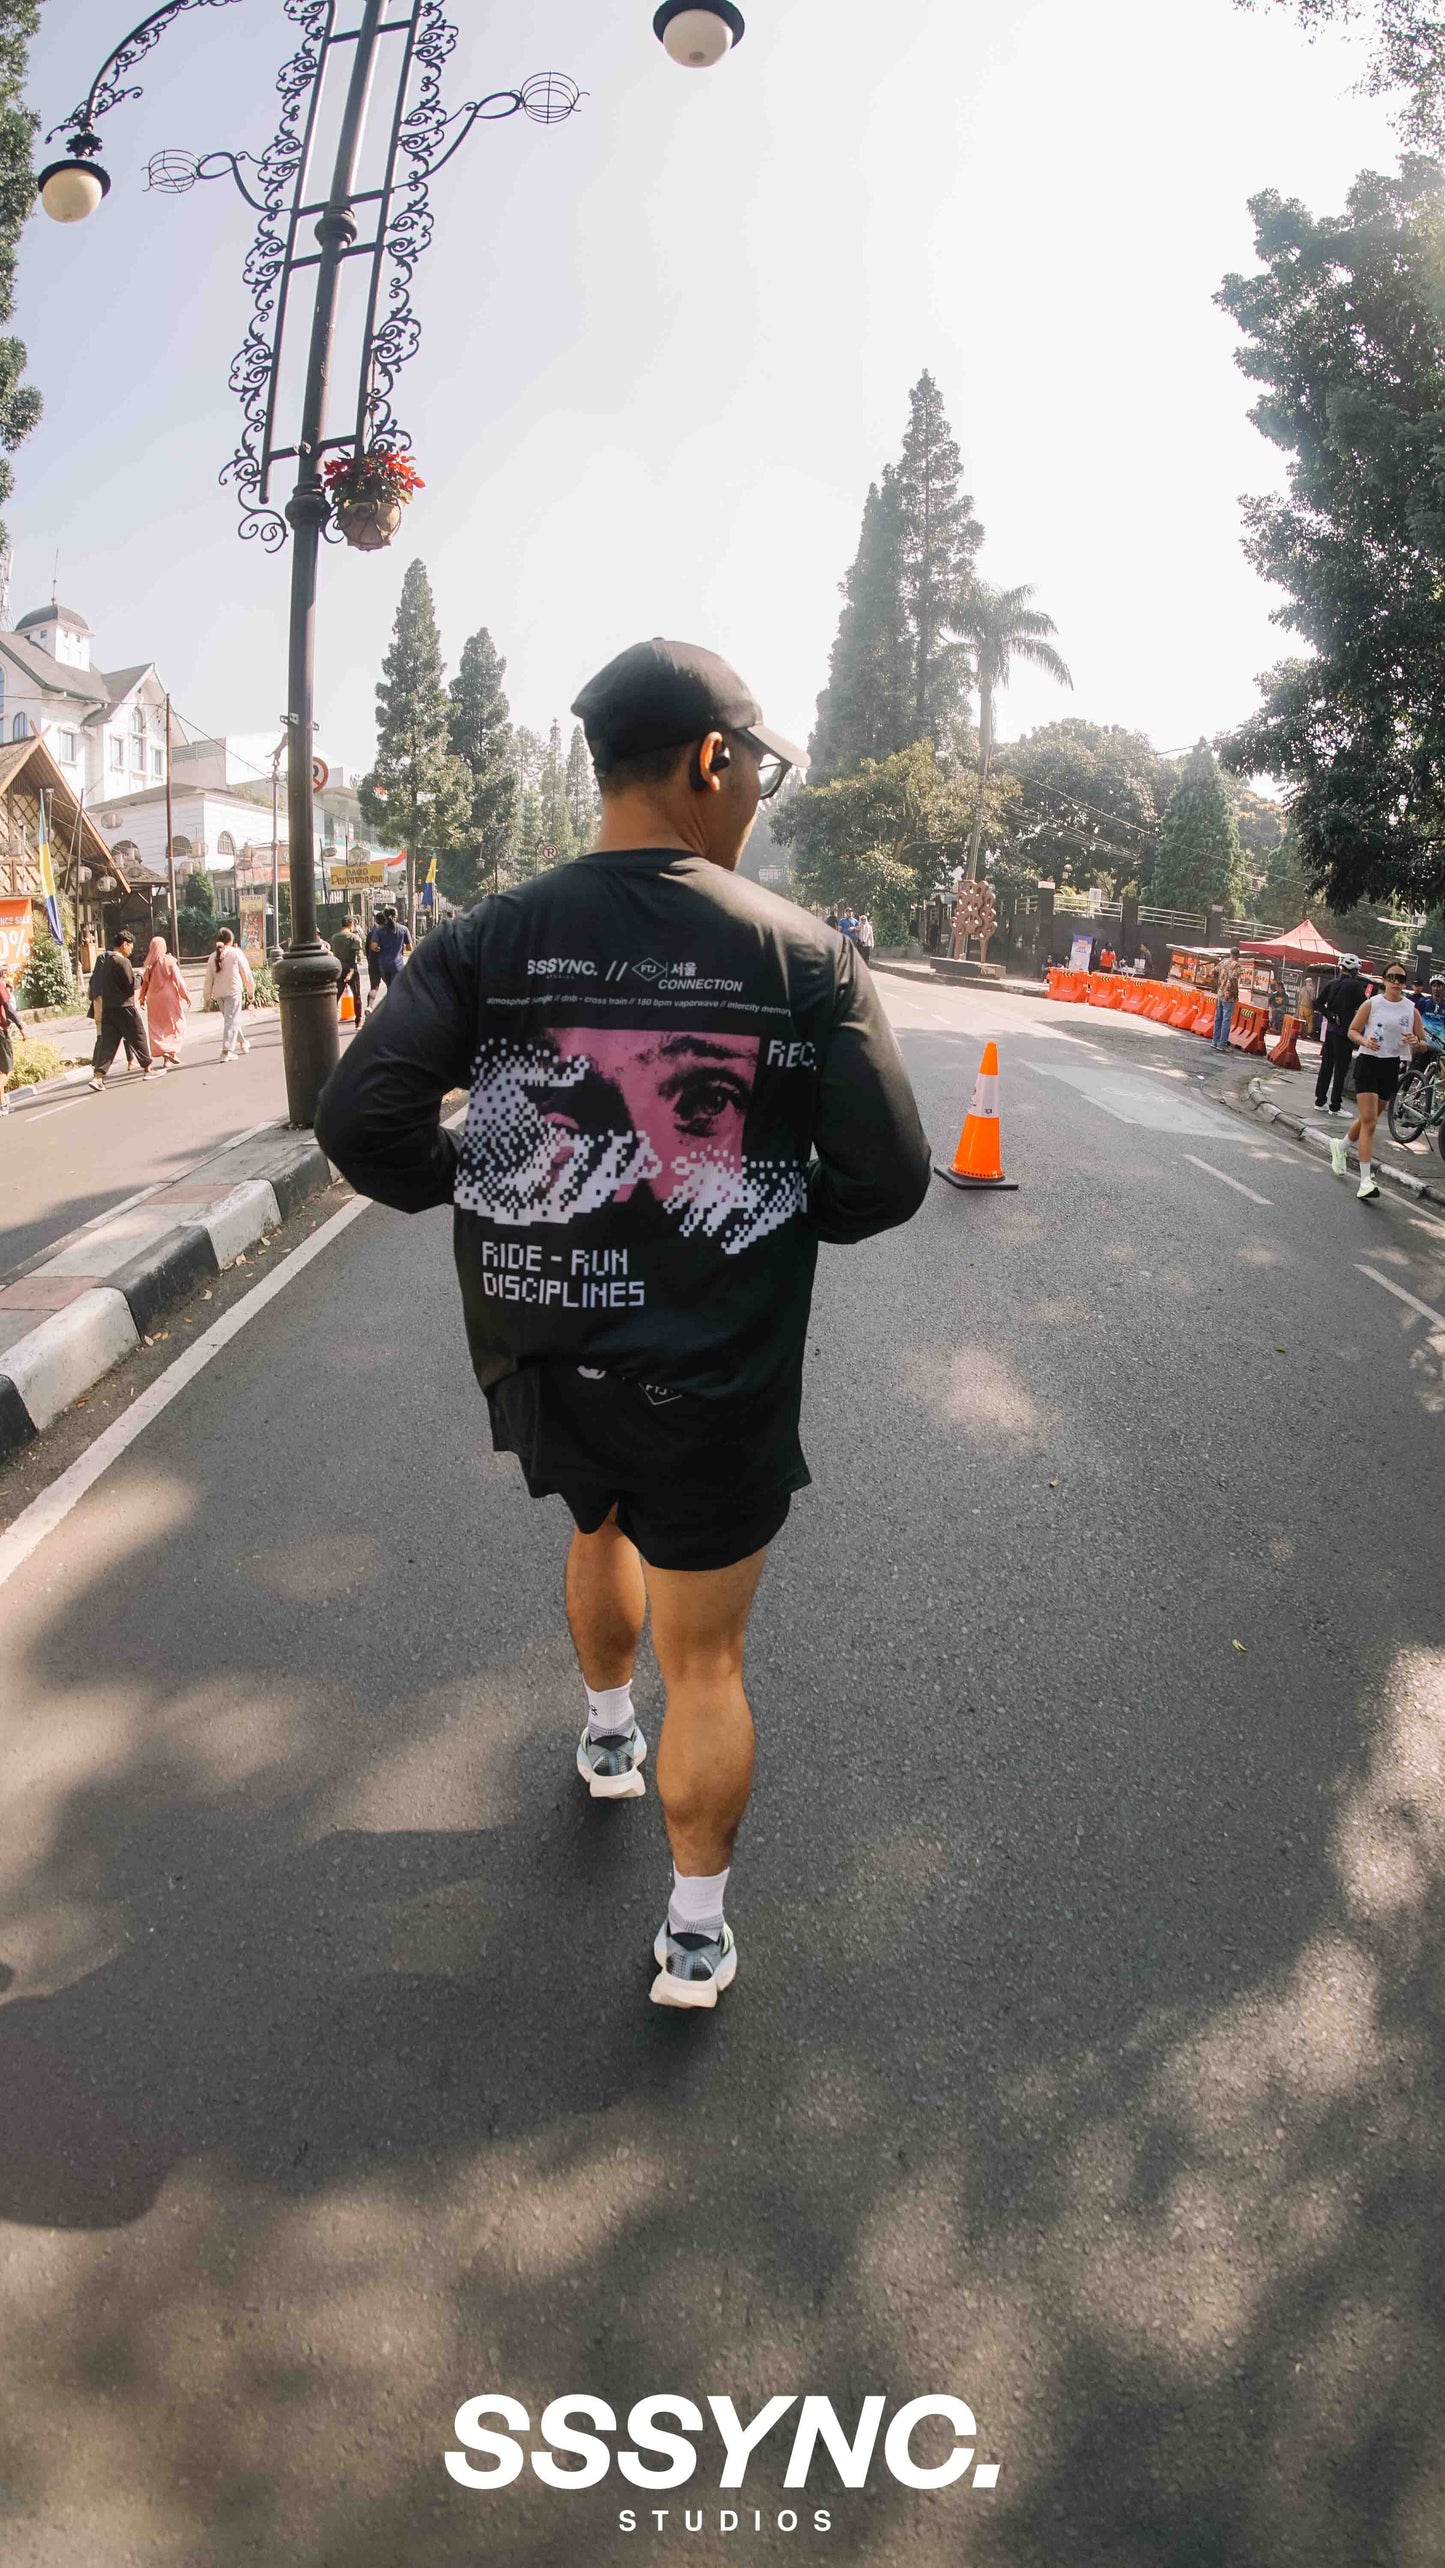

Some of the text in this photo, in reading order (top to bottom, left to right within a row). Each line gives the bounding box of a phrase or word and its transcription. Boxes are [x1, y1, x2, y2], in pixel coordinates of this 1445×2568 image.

[345, 868, 369, 877] DAGO
[640, 964, 657, 973] FTJ
[670, 962, 697, 977] 서울
[658, 978, 743, 992] CONNECTION
[584, 996, 607, 1005] cross
[608, 997, 628, 1006] train
[653, 998, 672, 1008] bpm
[674, 999, 719, 1009] vaporwave
[727, 1001, 760, 1013] intercity
[766, 1039, 817, 1071] REC
[482, 1241, 542, 1272] RIDE
[571, 1249, 628, 1276] RUN
[482, 1272, 645, 1308] DISCIPLINES
